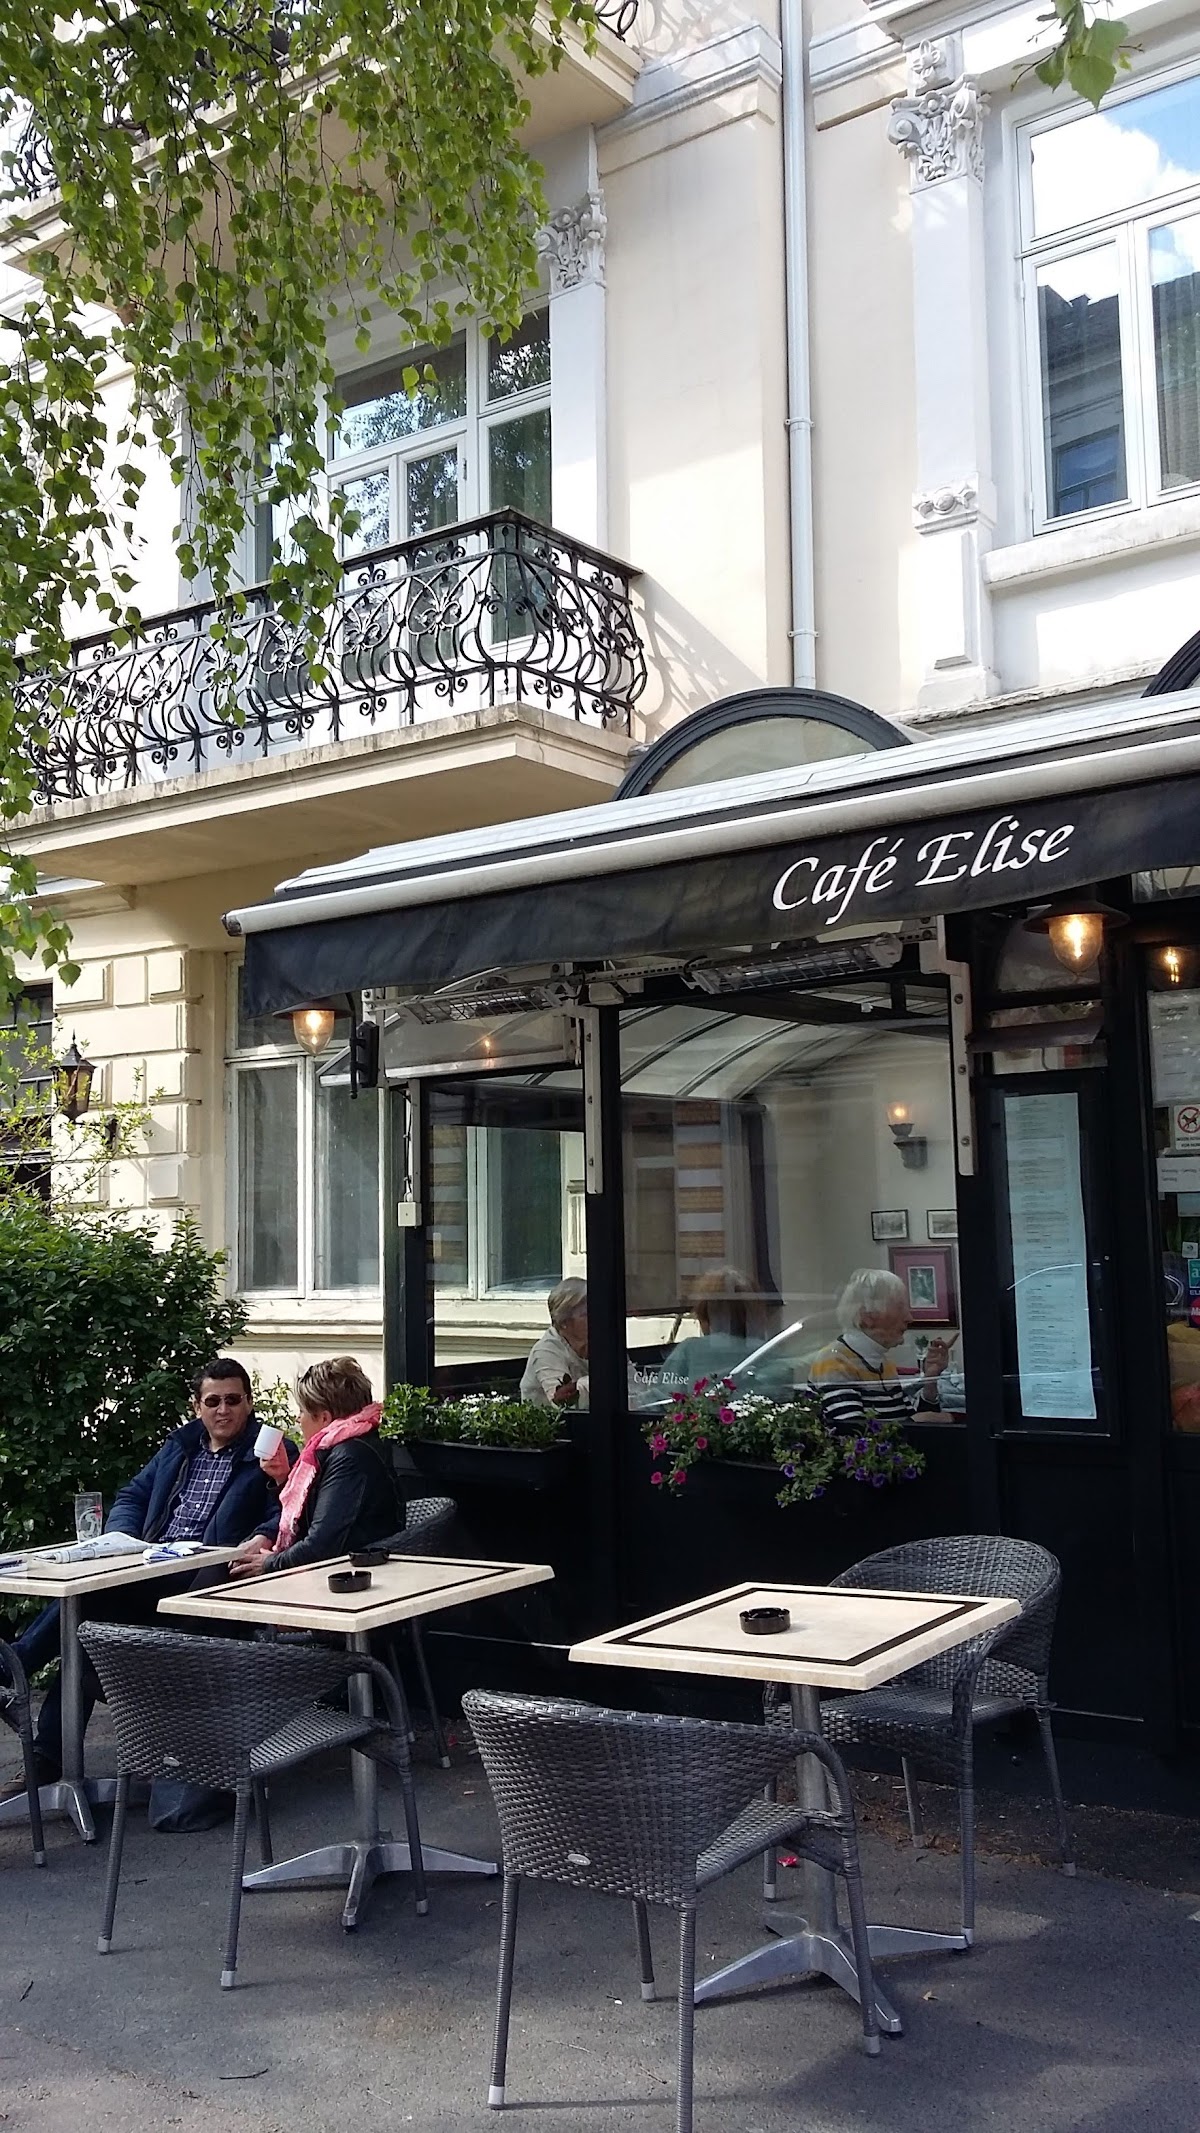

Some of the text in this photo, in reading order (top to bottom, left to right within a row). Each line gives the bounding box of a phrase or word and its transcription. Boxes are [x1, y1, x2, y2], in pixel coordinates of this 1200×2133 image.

[772, 815, 1075, 925] Café Elise
[633, 1371, 690, 1386] Café Elise
